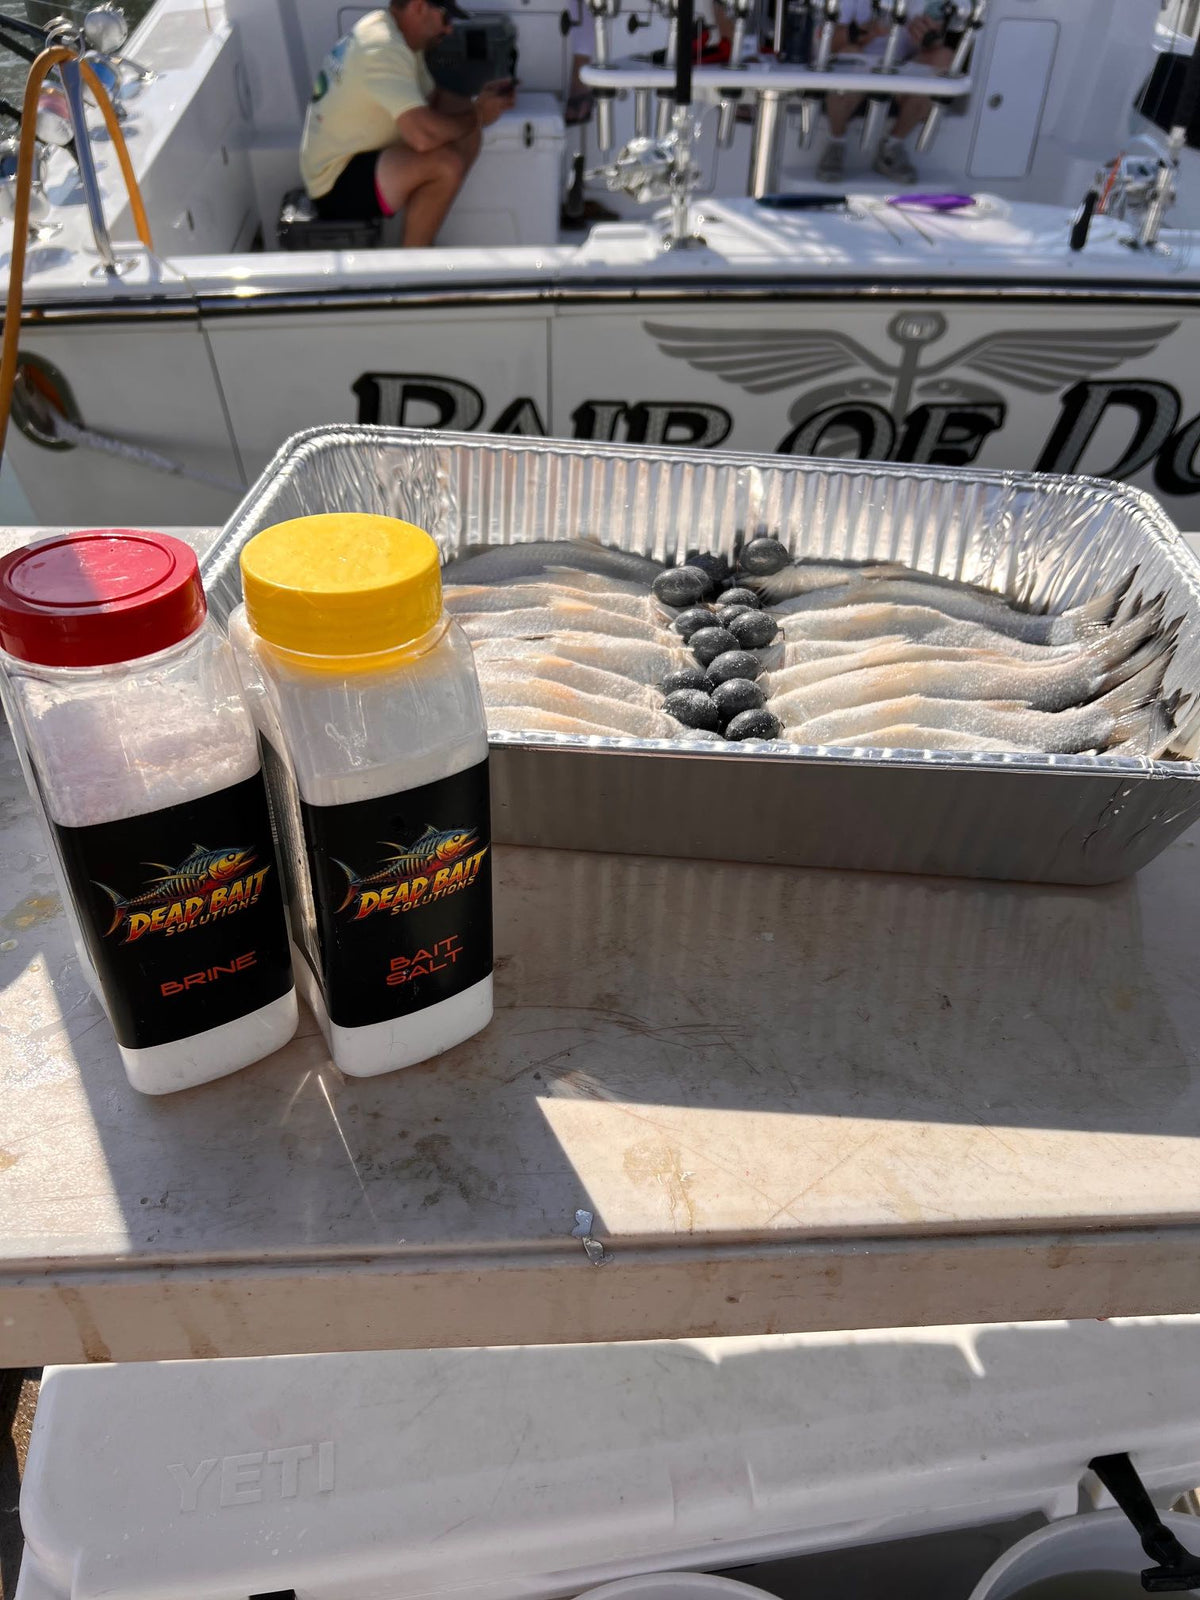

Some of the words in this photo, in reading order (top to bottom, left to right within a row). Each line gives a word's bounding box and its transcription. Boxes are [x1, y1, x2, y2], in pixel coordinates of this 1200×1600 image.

[776, 402, 1007, 465] OF
[126, 897, 203, 942] DEAD
[210, 866, 271, 913] BAIT
[354, 876, 428, 920] DEAD
[432, 847, 488, 893] BAIT
[390, 874, 476, 916] SOLUTIONS
[165, 894, 259, 937] SOLUTIONS
[160, 951, 257, 997] BRINE
[386, 946, 463, 986] SALT
[390, 935, 458, 972] BAIT
[166, 1440, 335, 1515] YETI
